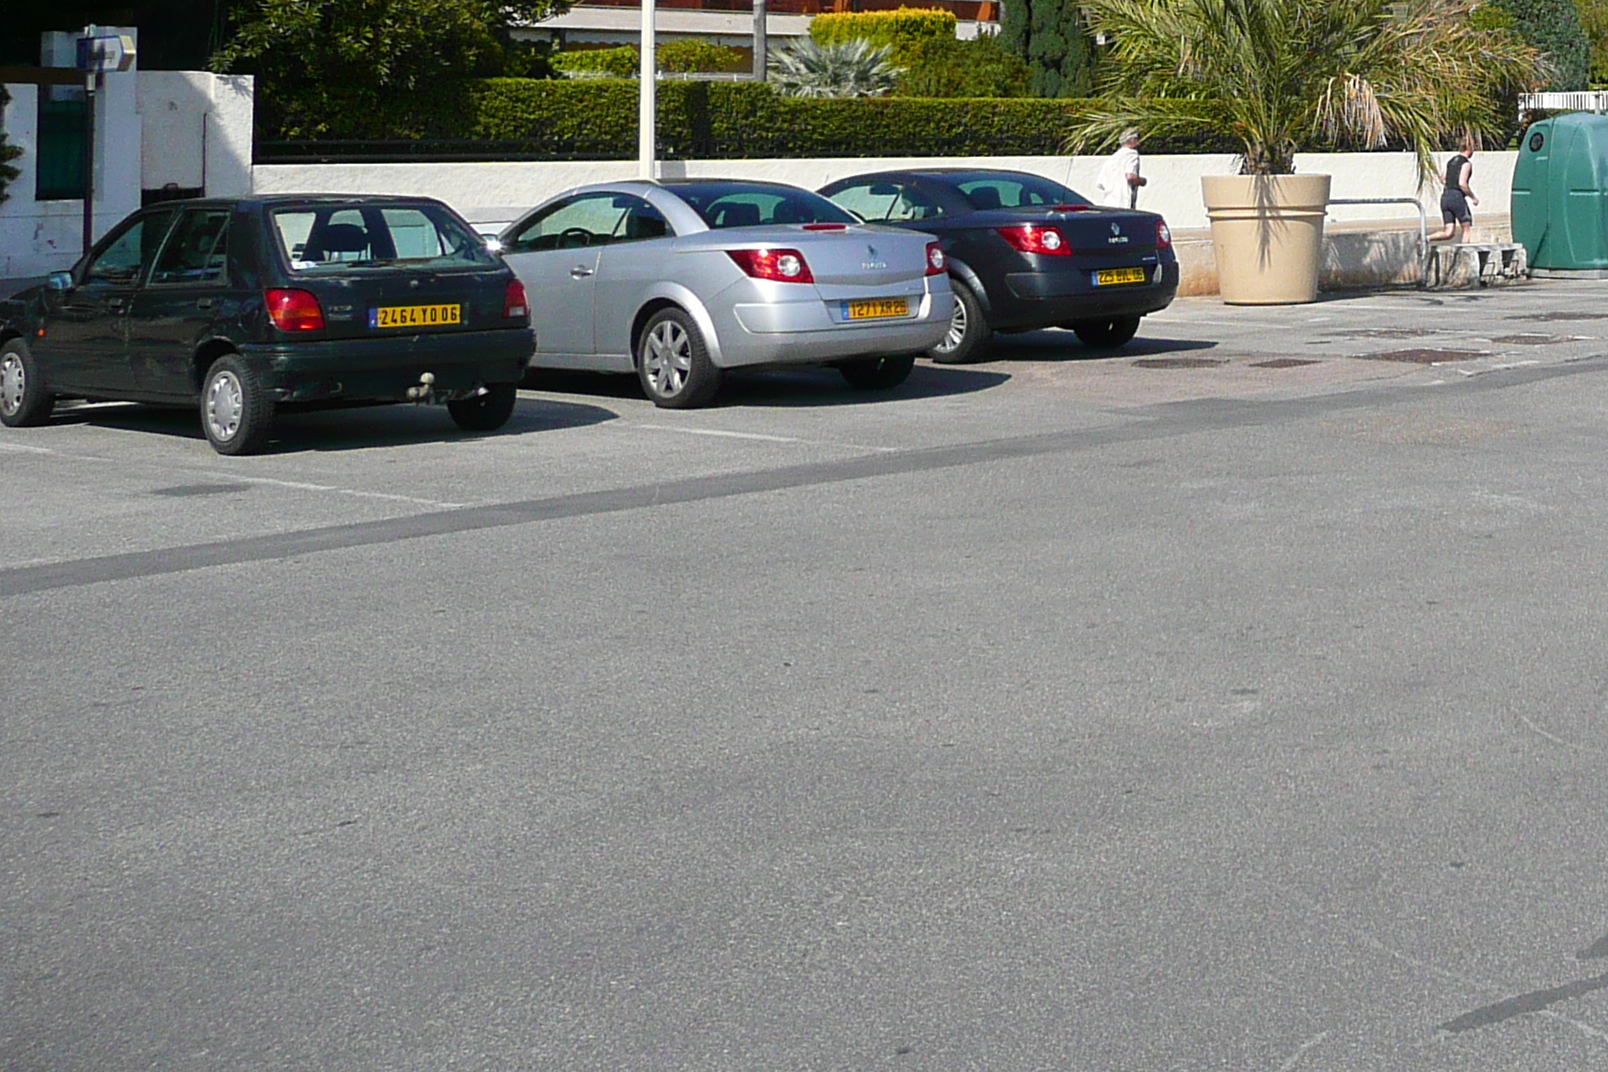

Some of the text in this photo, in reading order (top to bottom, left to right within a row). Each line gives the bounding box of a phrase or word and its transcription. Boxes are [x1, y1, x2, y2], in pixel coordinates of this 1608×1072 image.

[381, 309, 416, 325] 2464
[441, 307, 457, 321] 06
[851, 301, 877, 317] 1271
